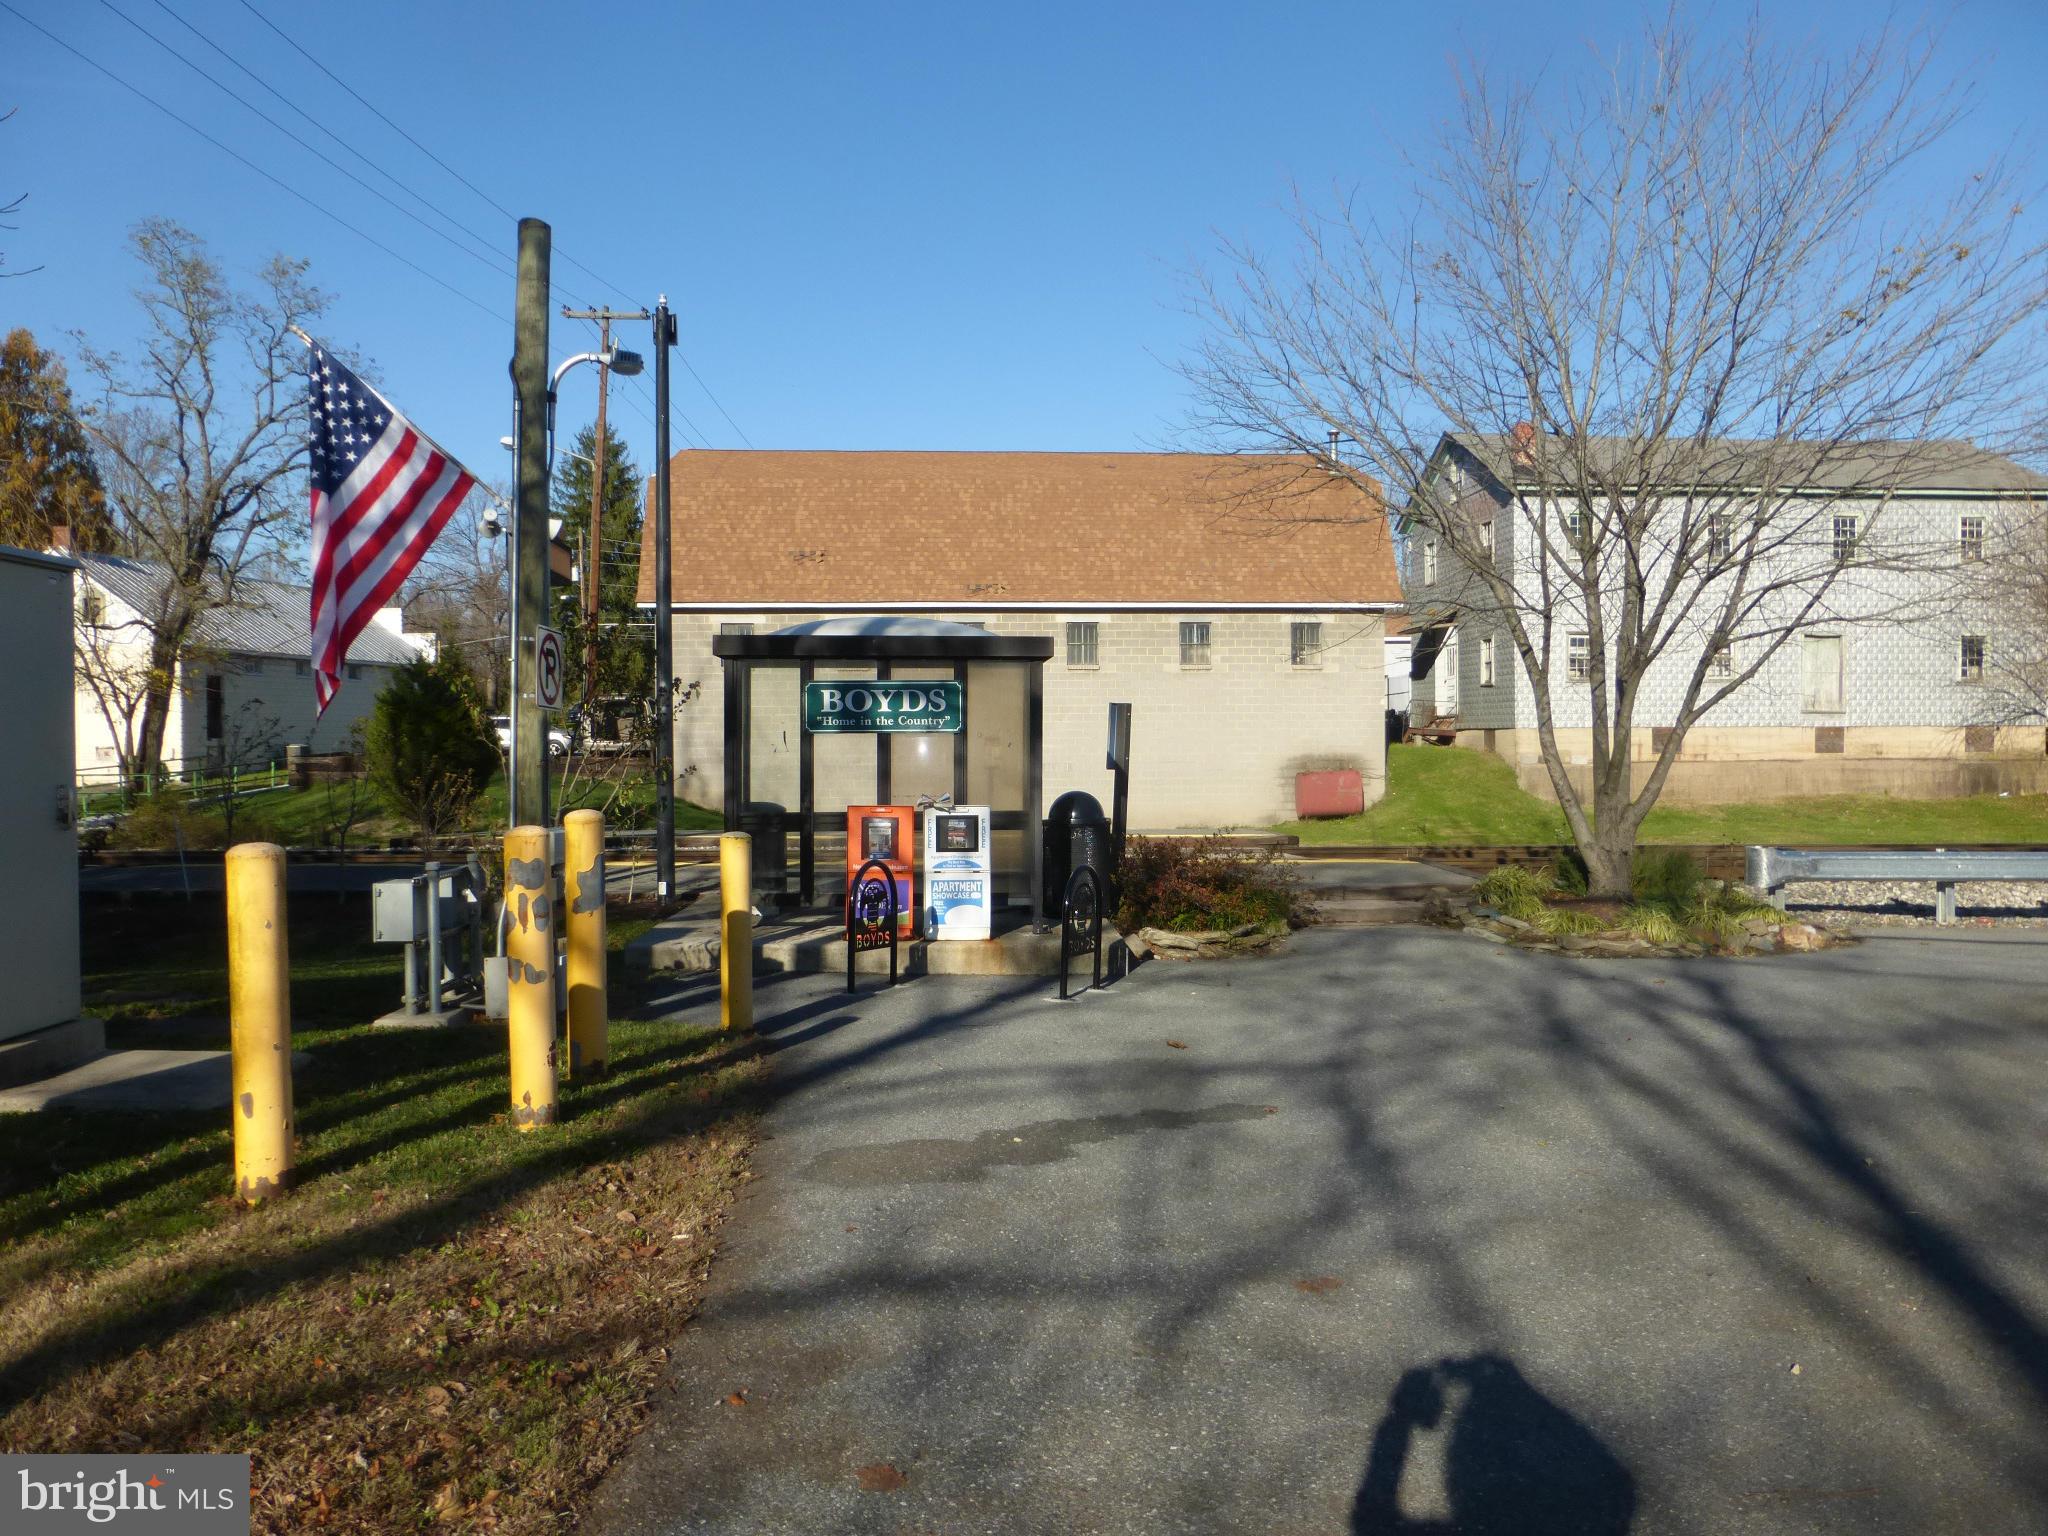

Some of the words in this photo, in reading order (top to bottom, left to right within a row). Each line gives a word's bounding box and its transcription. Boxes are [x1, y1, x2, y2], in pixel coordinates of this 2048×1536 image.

[820, 689, 947, 712] BOYDS
[860, 715, 872, 726] in
[876, 715, 894, 726] the
[932, 881, 982, 892] APARTMENT
[932, 891, 970, 900] SHOWCASE
[856, 930, 890, 949] BOYDS
